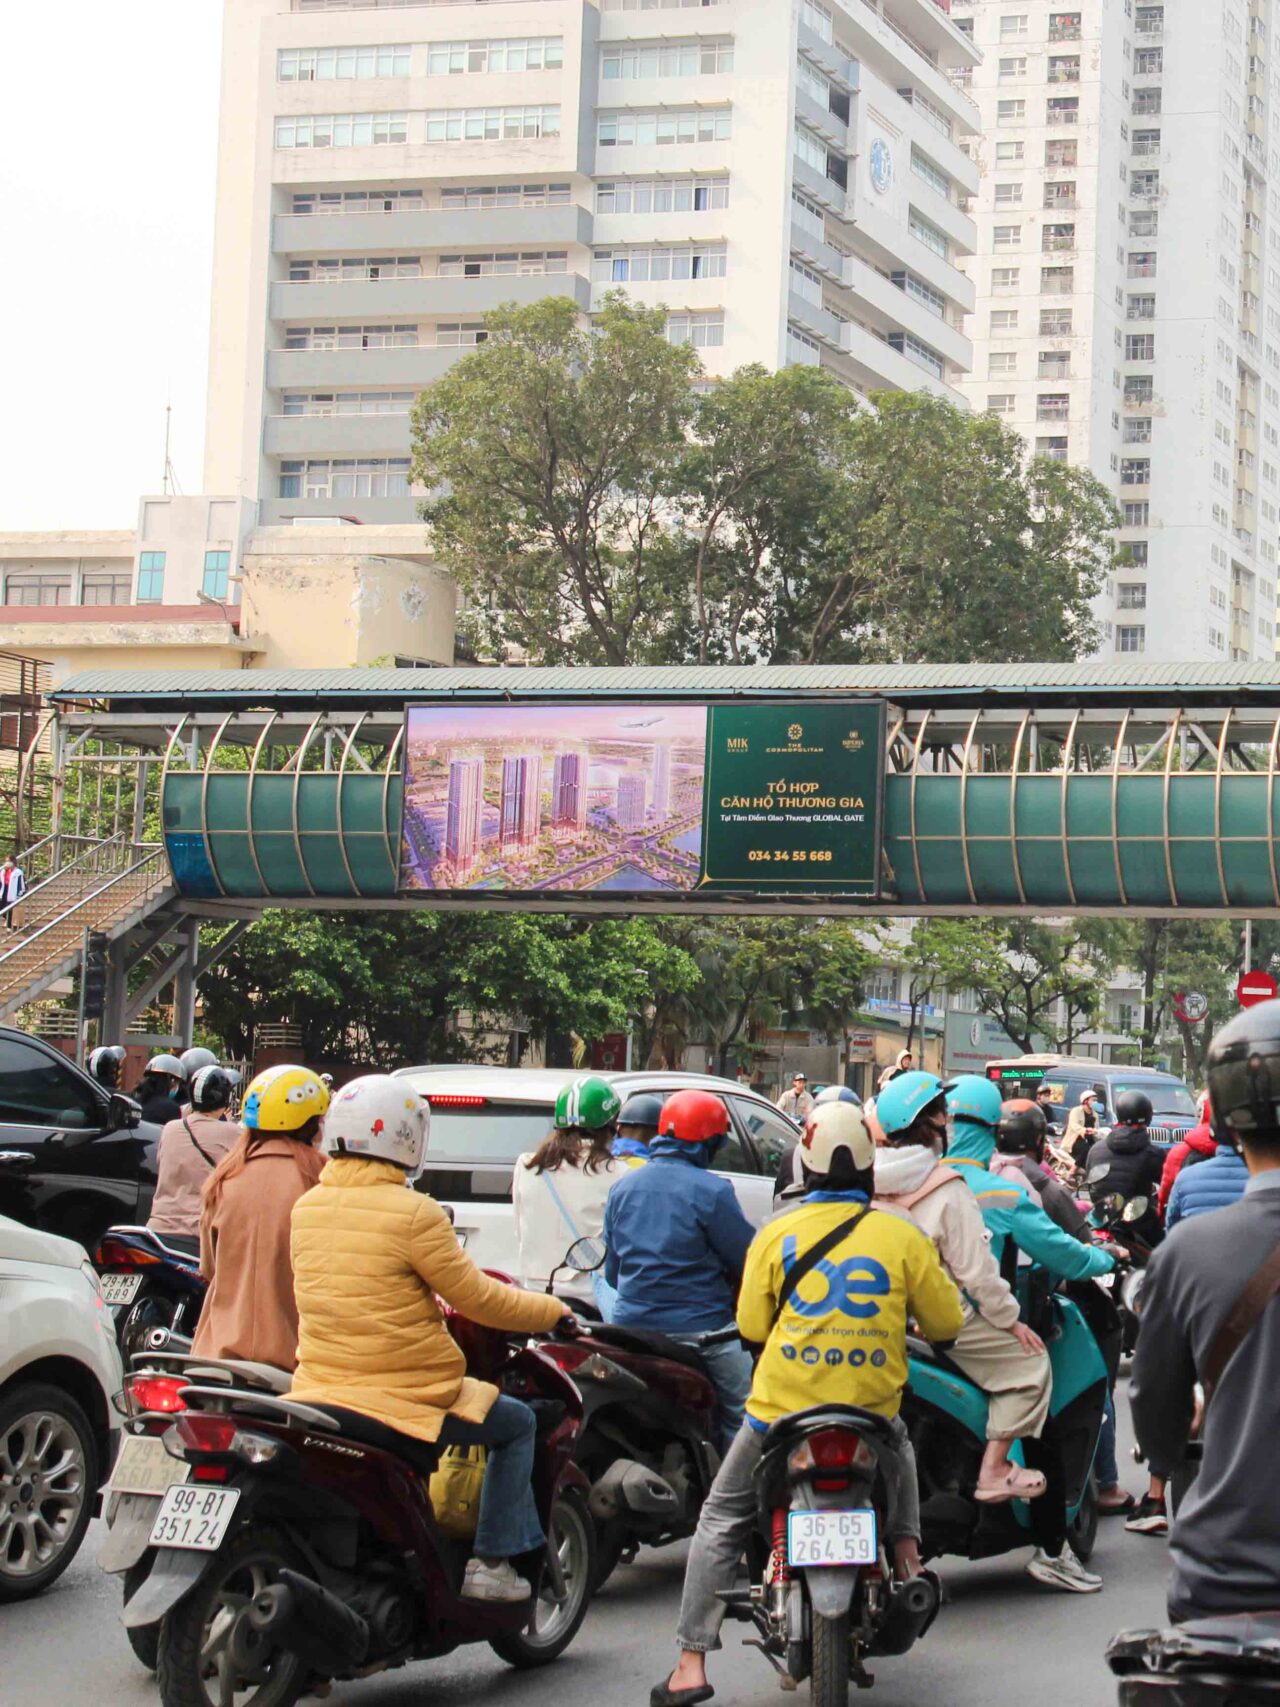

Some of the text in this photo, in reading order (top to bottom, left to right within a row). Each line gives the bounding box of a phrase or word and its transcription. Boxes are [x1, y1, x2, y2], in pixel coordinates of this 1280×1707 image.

[727, 738, 749, 748] MIK
[789, 782, 820, 795] HỢP
[721, 795, 865, 810] CĂN HỘ THƯƠNG GIA
[749, 851, 832, 861] 034 34 55 668
[782, 1234, 891, 1319] be
[171, 1489, 226, 1517] 99-B1
[154, 1517, 219, 1545] 351.24
[803, 1515, 862, 1537] 36-G5
[796, 1539, 870, 1562] 264.59
